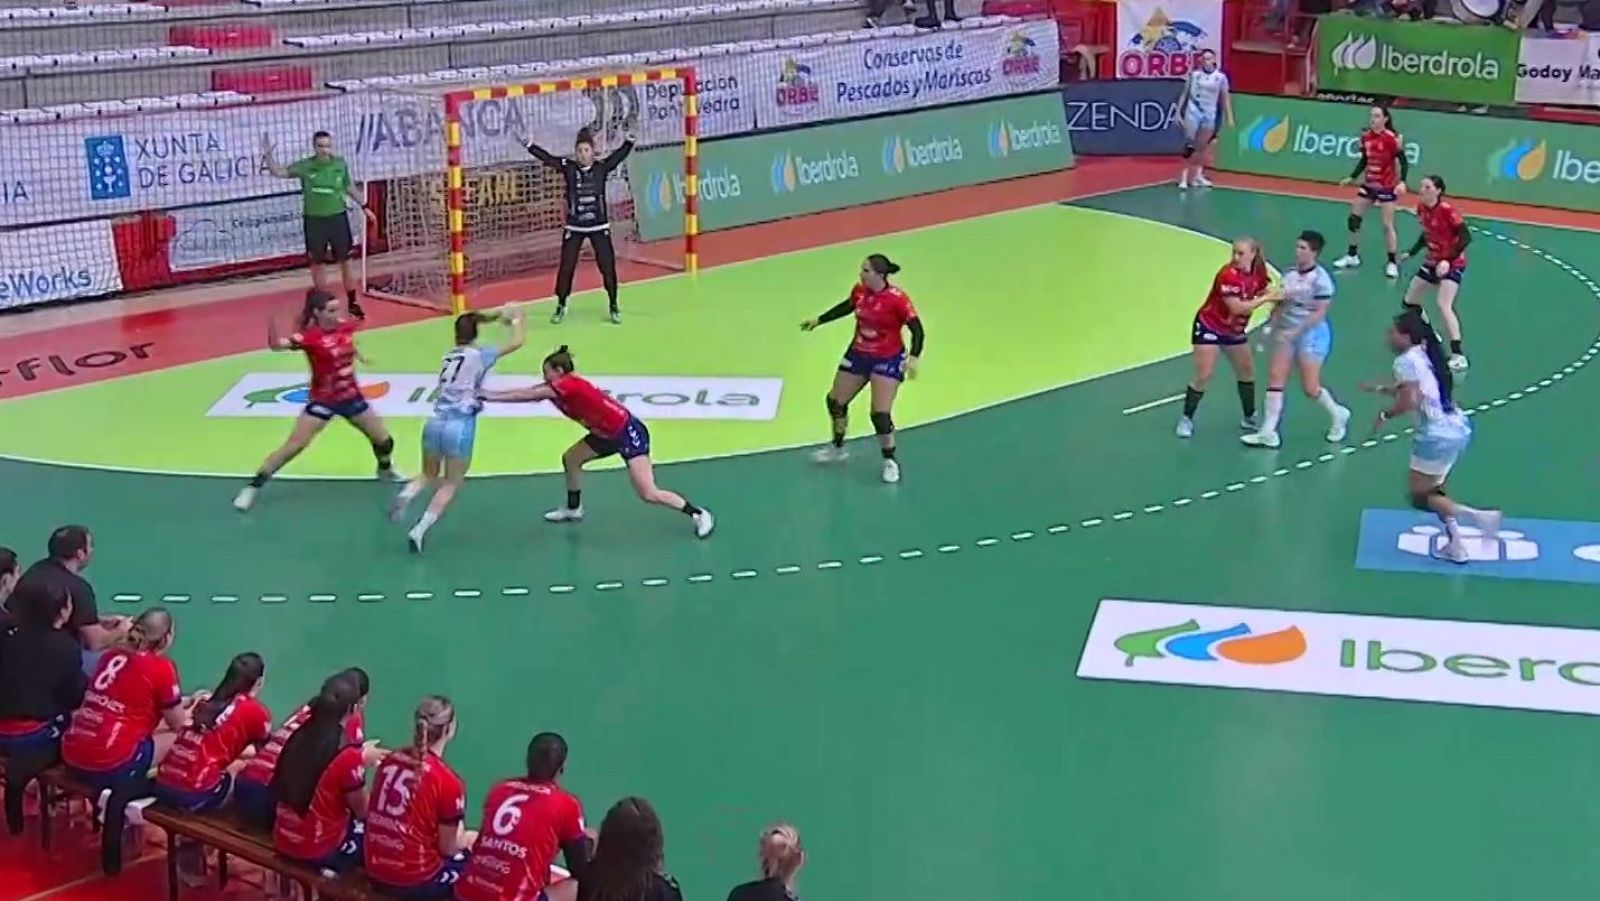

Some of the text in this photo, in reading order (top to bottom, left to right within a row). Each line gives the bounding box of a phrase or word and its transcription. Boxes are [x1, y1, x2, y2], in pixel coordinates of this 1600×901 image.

[864, 40, 963, 70] Conservas de
[1380, 44, 1500, 80] Iberdrola
[837, 74, 909, 102] Pescados
[925, 68, 992, 91] Mariscos
[1516, 63, 1572, 83] Godoy
[135, 132, 221, 160] XUNTA
[905, 135, 963, 167] Iberdrola
[1008, 119, 1063, 151] Iberdrola
[137, 154, 272, 188] DE GALICIA
[795, 149, 859, 186] Iberdrola
[672, 168, 741, 204] Ibrdrola
[94, 654, 128, 690] 8
[376, 764, 415, 817] 15
[492, 794, 530, 836] 6
[480, 835, 528, 859] SANTOS
